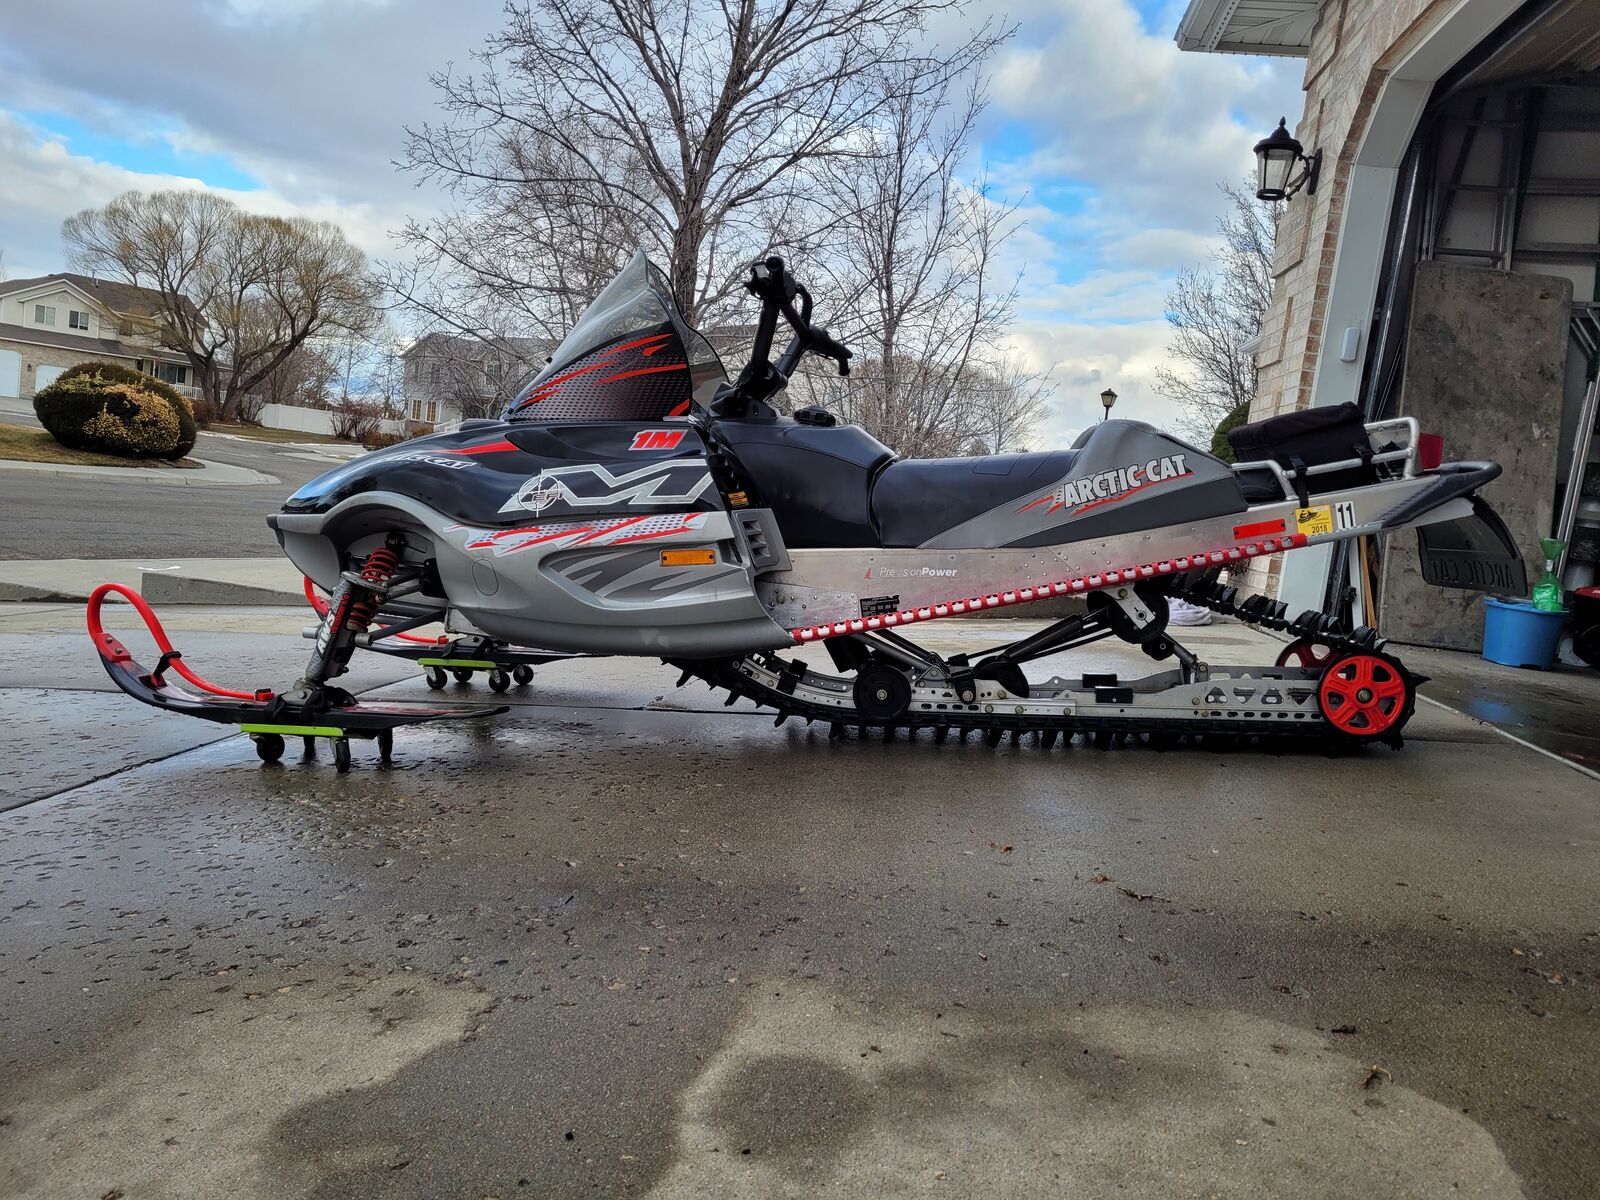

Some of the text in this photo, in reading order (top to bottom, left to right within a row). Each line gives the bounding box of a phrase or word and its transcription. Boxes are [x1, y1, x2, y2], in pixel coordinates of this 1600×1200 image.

[629, 430, 688, 450] 1M
[1064, 453, 1187, 508] ARCTIC CAT
[1338, 503, 1354, 529] 11
[1311, 525, 1328, 534] 2018
